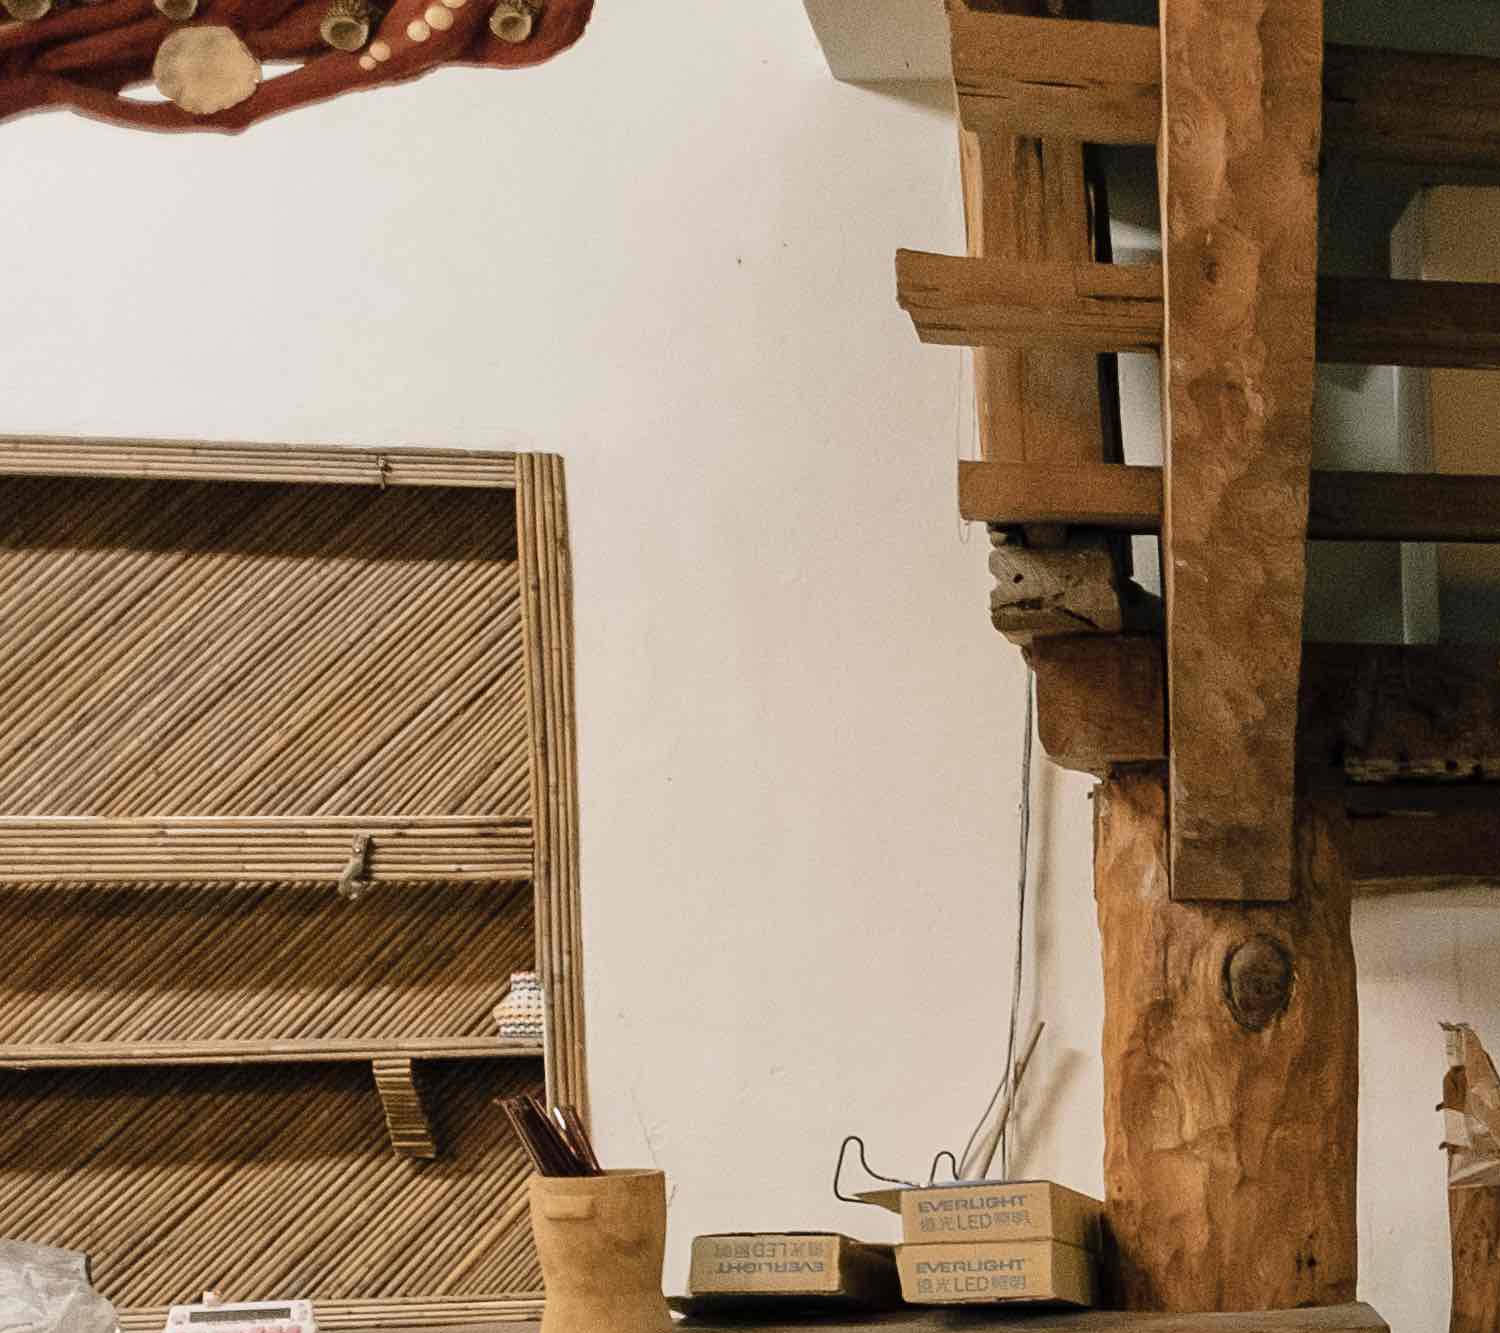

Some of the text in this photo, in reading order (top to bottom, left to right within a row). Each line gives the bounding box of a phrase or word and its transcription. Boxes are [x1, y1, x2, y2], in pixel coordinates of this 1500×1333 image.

[918, 1195, 1026, 1213] EVERLIGHT
[717, 1260, 824, 1274] EVERLIGHT
[916, 1258, 1026, 1274] EVERLIGHT
